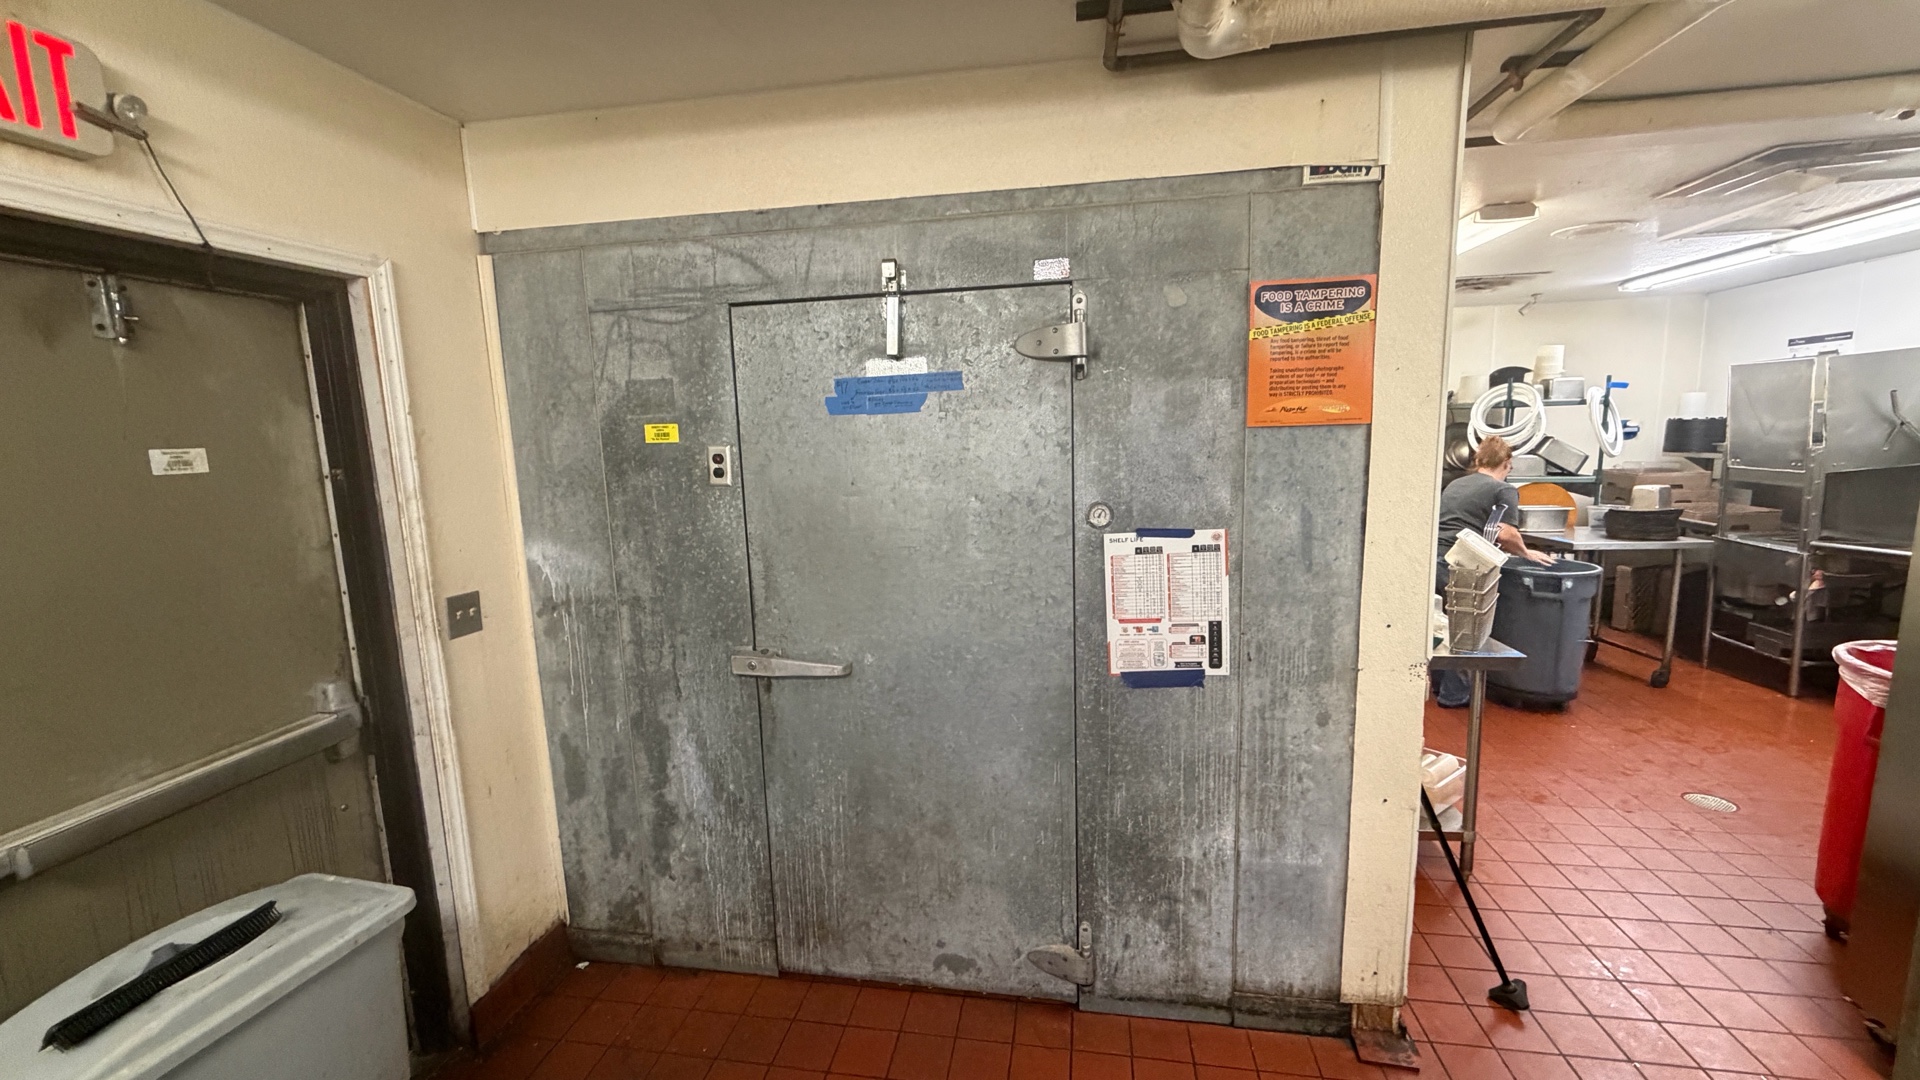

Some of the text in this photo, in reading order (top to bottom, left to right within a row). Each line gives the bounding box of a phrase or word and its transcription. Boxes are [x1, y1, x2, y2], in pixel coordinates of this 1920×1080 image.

[0, 19, 78, 140] IT
[1260, 286, 1366, 303] FOOD TAMPERING
[1280, 299, 1345, 314] IS A CRIME
[1253, 329, 1269, 338] FOOD
[1270, 324, 1303, 335] TAMPERING
[1317, 317, 1343, 328] FEDERAL
[1344, 312, 1372, 323] OFFENSE
[1109, 535, 1144, 544] SHELF LIFE
